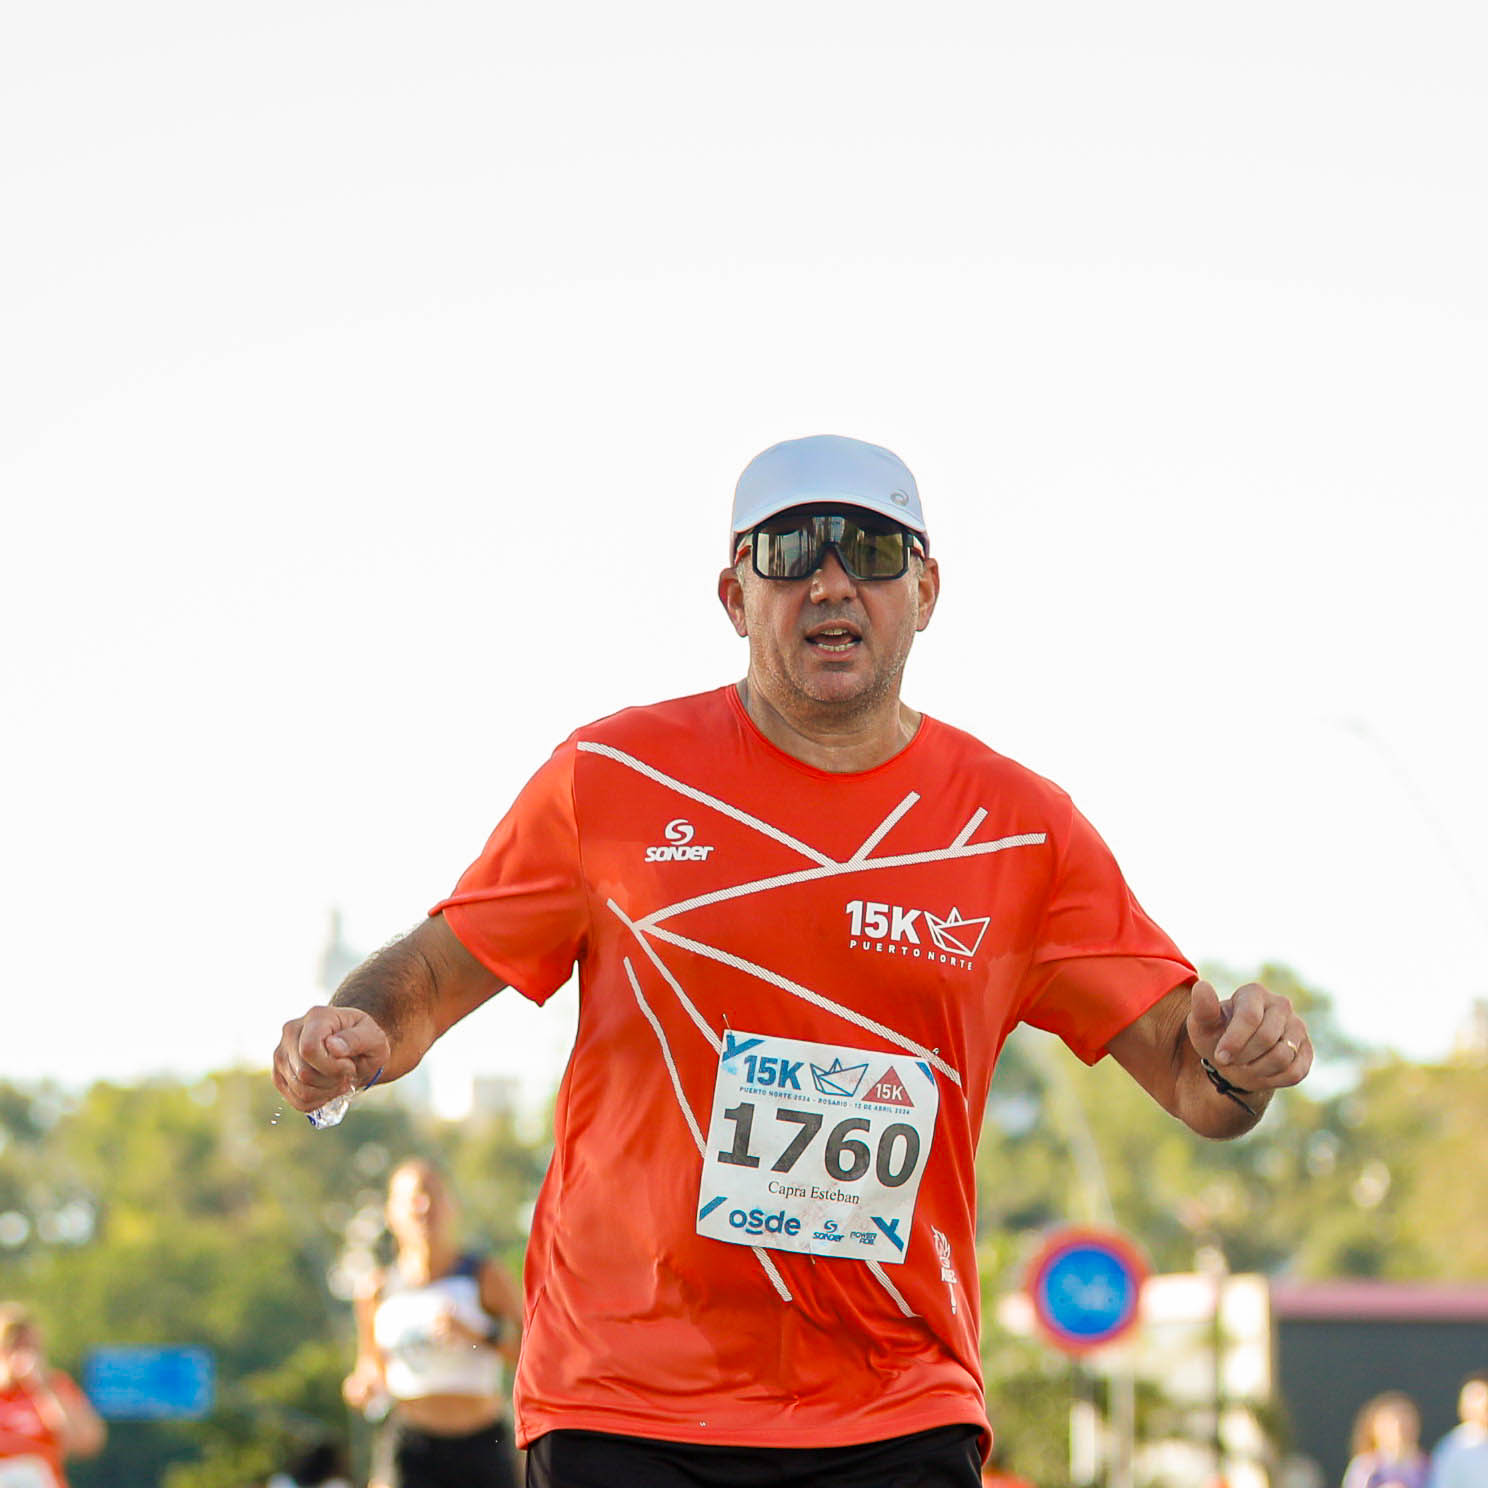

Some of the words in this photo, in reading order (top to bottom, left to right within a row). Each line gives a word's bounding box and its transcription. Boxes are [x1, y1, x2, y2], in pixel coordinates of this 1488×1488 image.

[845, 899, 922, 945] 15K
[849, 939, 921, 958] PUERTO
[927, 950, 974, 971] NORTE
[744, 1054, 805, 1091] 15K
[739, 1086, 767, 1096] PUERTO
[768, 1090, 793, 1100] NORTE
[817, 1097, 848, 1108] ROSARIO
[863, 1103, 872, 1111] DE
[873, 1104, 893, 1113] ABRIL
[875, 1082, 904, 1101] 15K
[717, 1101, 921, 1188] 1760
[768, 1180, 807, 1199] Capra
[810, 1185, 860, 1205] Esteban
[728, 1208, 801, 1236] osde
